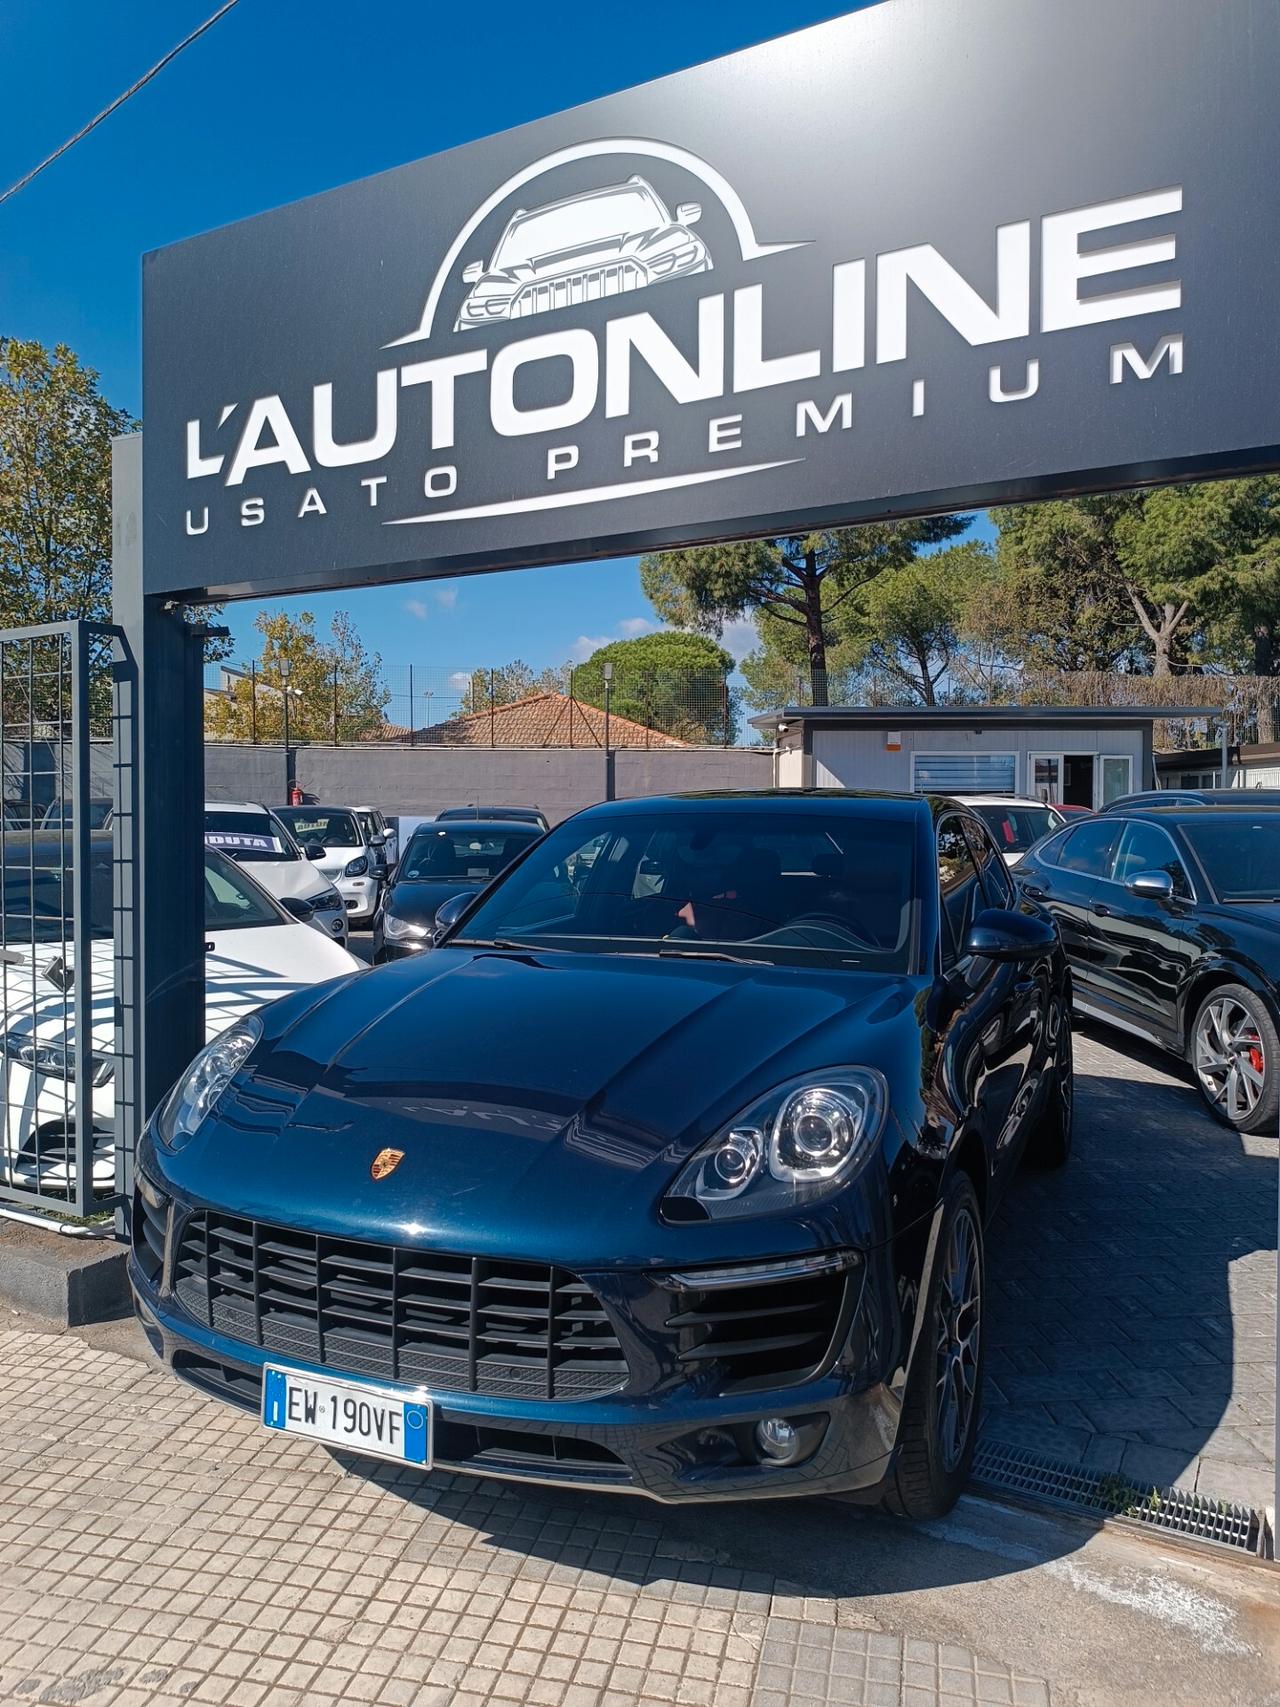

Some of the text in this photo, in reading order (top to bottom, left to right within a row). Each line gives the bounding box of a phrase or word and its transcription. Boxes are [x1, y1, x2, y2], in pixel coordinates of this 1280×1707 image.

[186, 333, 1183, 536] USATO PREMIUM
[204, 835, 268, 848] DUTA
